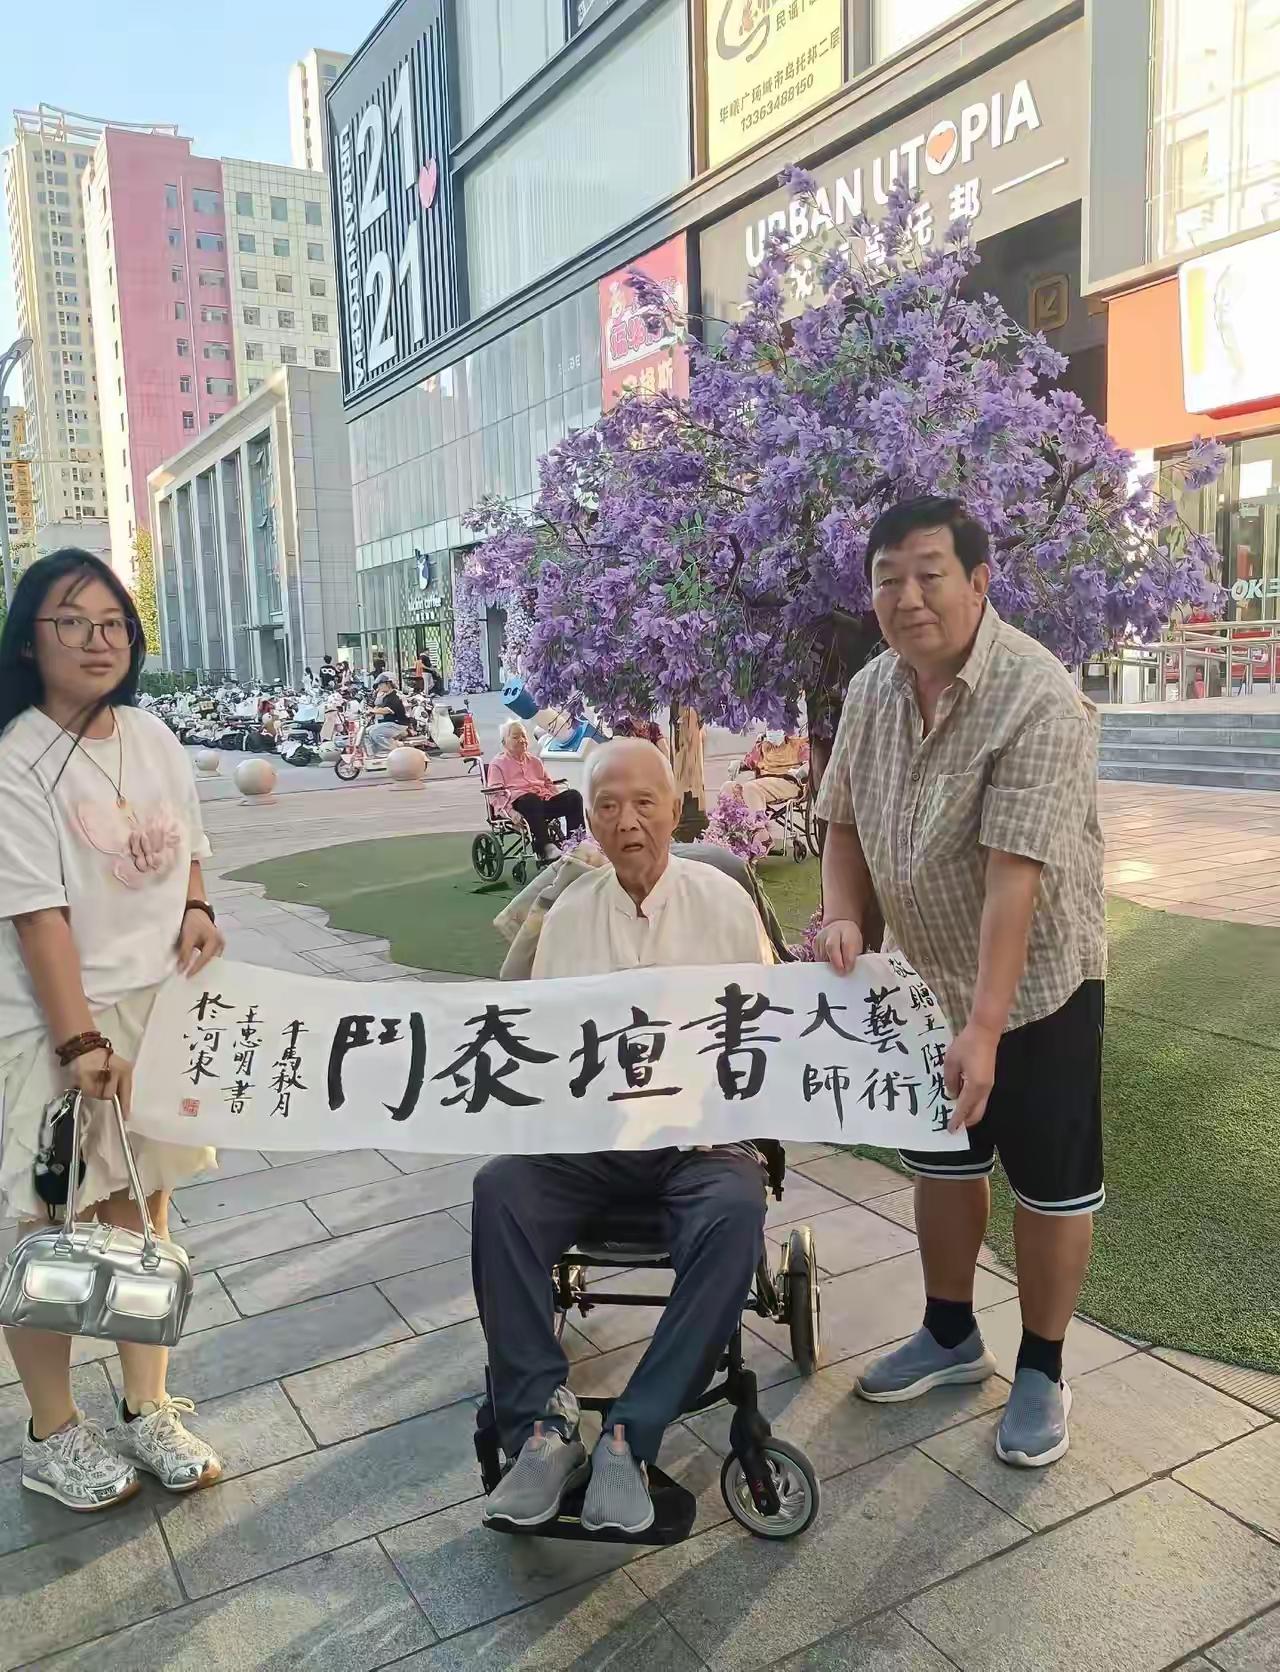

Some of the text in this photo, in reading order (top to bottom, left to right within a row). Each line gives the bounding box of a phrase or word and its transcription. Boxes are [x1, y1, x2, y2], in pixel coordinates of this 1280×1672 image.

[357, 62, 418, 234] 21
[741, 73, 814, 132] 13363488150
[873, 80, 1041, 205] UTOPIA
[366, 219, 425, 369] 21
